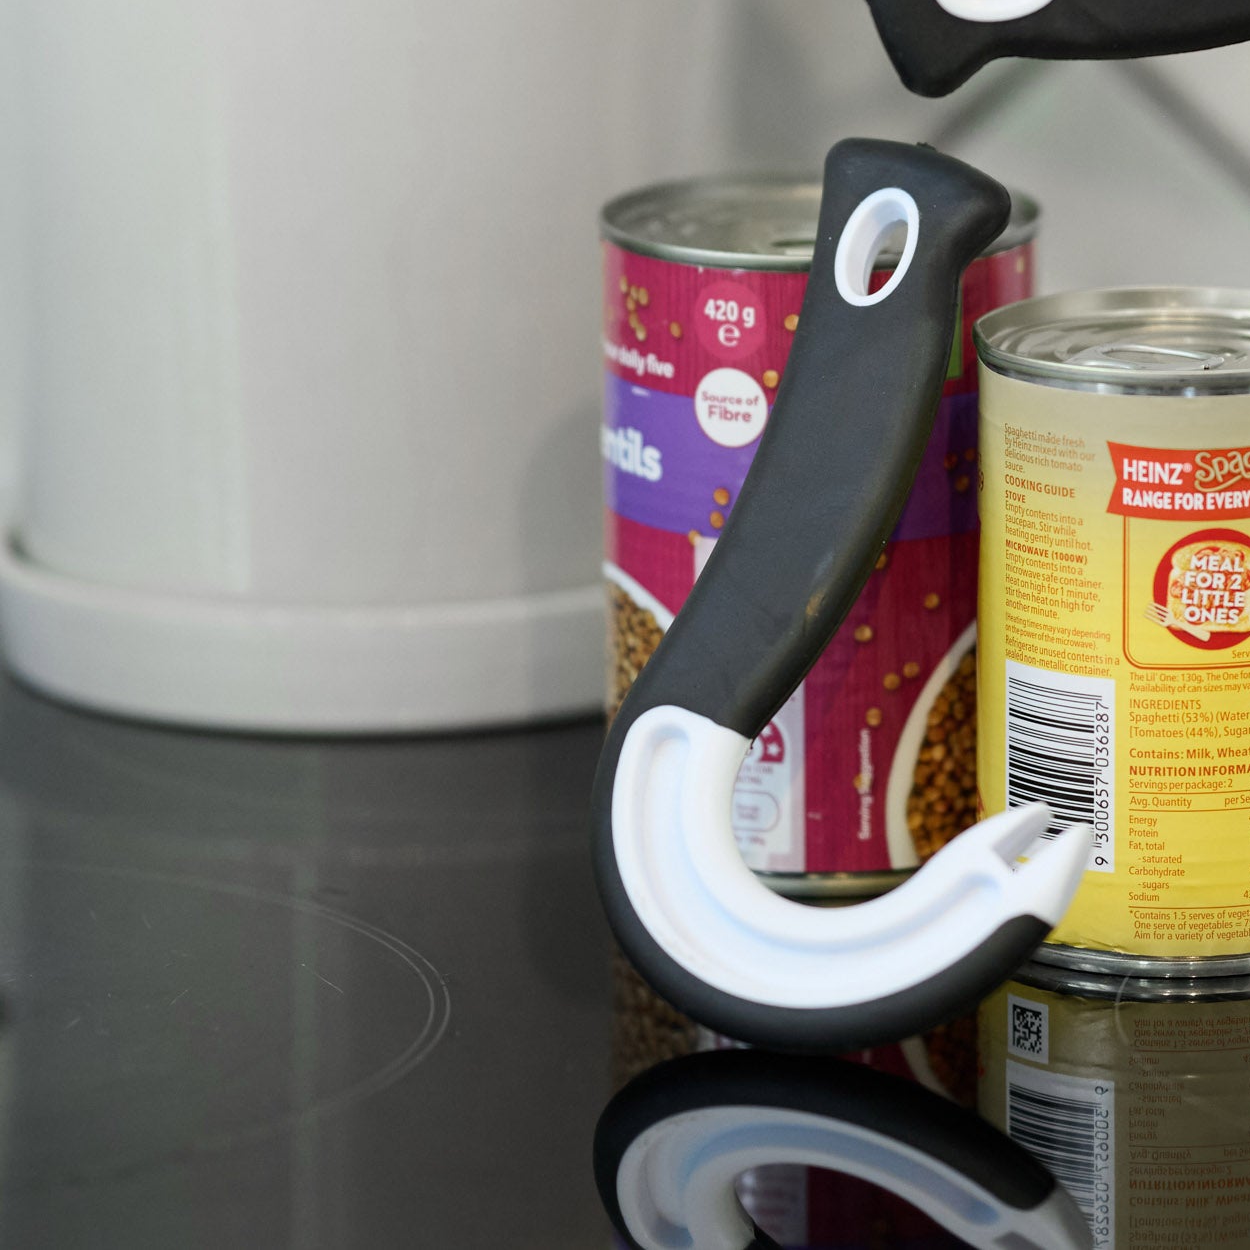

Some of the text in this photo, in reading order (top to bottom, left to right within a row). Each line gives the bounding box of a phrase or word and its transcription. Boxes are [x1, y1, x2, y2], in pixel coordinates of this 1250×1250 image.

[704, 298, 756, 329] 420 g
[646, 352, 675, 379] five
[701, 390, 760, 406] Source of
[707, 405, 752, 424] Fibre
[1005, 474, 1076, 499] COOKING GUIDE
[1005, 490, 1026, 503] STOVE
[1122, 487, 1173, 510] RANGE
[1174, 492, 1204, 511] FOR
[1005, 514, 1077, 537] saucepan. Stir while
[1005, 539, 1088, 565] MICROWAVE (1000W)
[1190, 555, 1245, 573] MEAL
[1185, 572, 1243, 591] FOR 2
[1182, 589, 1246, 609] LITTLE
[1185, 606, 1241, 626] ONES
[1129, 699, 1201, 710] INGREDIENTS
[1129, 711, 1180, 726] Spaghetti
[1181, 711, 1213, 724] (53%)
[1129, 725, 1184, 738] [Tomatoes
[1185, 726, 1222, 738] (44%),
[1129, 748, 1184, 760] Contains:
[1186, 748, 1215, 760] Milk,
[1129, 765, 1197, 777] NUTRITION
[1129, 779, 1233, 792] Servings per package: 2
[1129, 796, 1192, 809] Avg. Quantity
[1224, 796, 1239, 807] per
[1129, 815, 1158, 827] Energy
[1129, 828, 1158, 838] Protein
[1128, 840, 1165, 851] Fat, total
[1128, 866, 1185, 878] Carbohydrate
[1128, 892, 1160, 902] Sodium
[1174, 911, 1187, 920] 1.5
[1189, 912, 1215, 920] serves
[1217, 910, 1226, 919] of
[1134, 931, 1151, 940] Aim
[1154, 931, 1165, 940] for
[1175, 931, 1204, 942] variety
[1205, 931, 1215, 940] of
